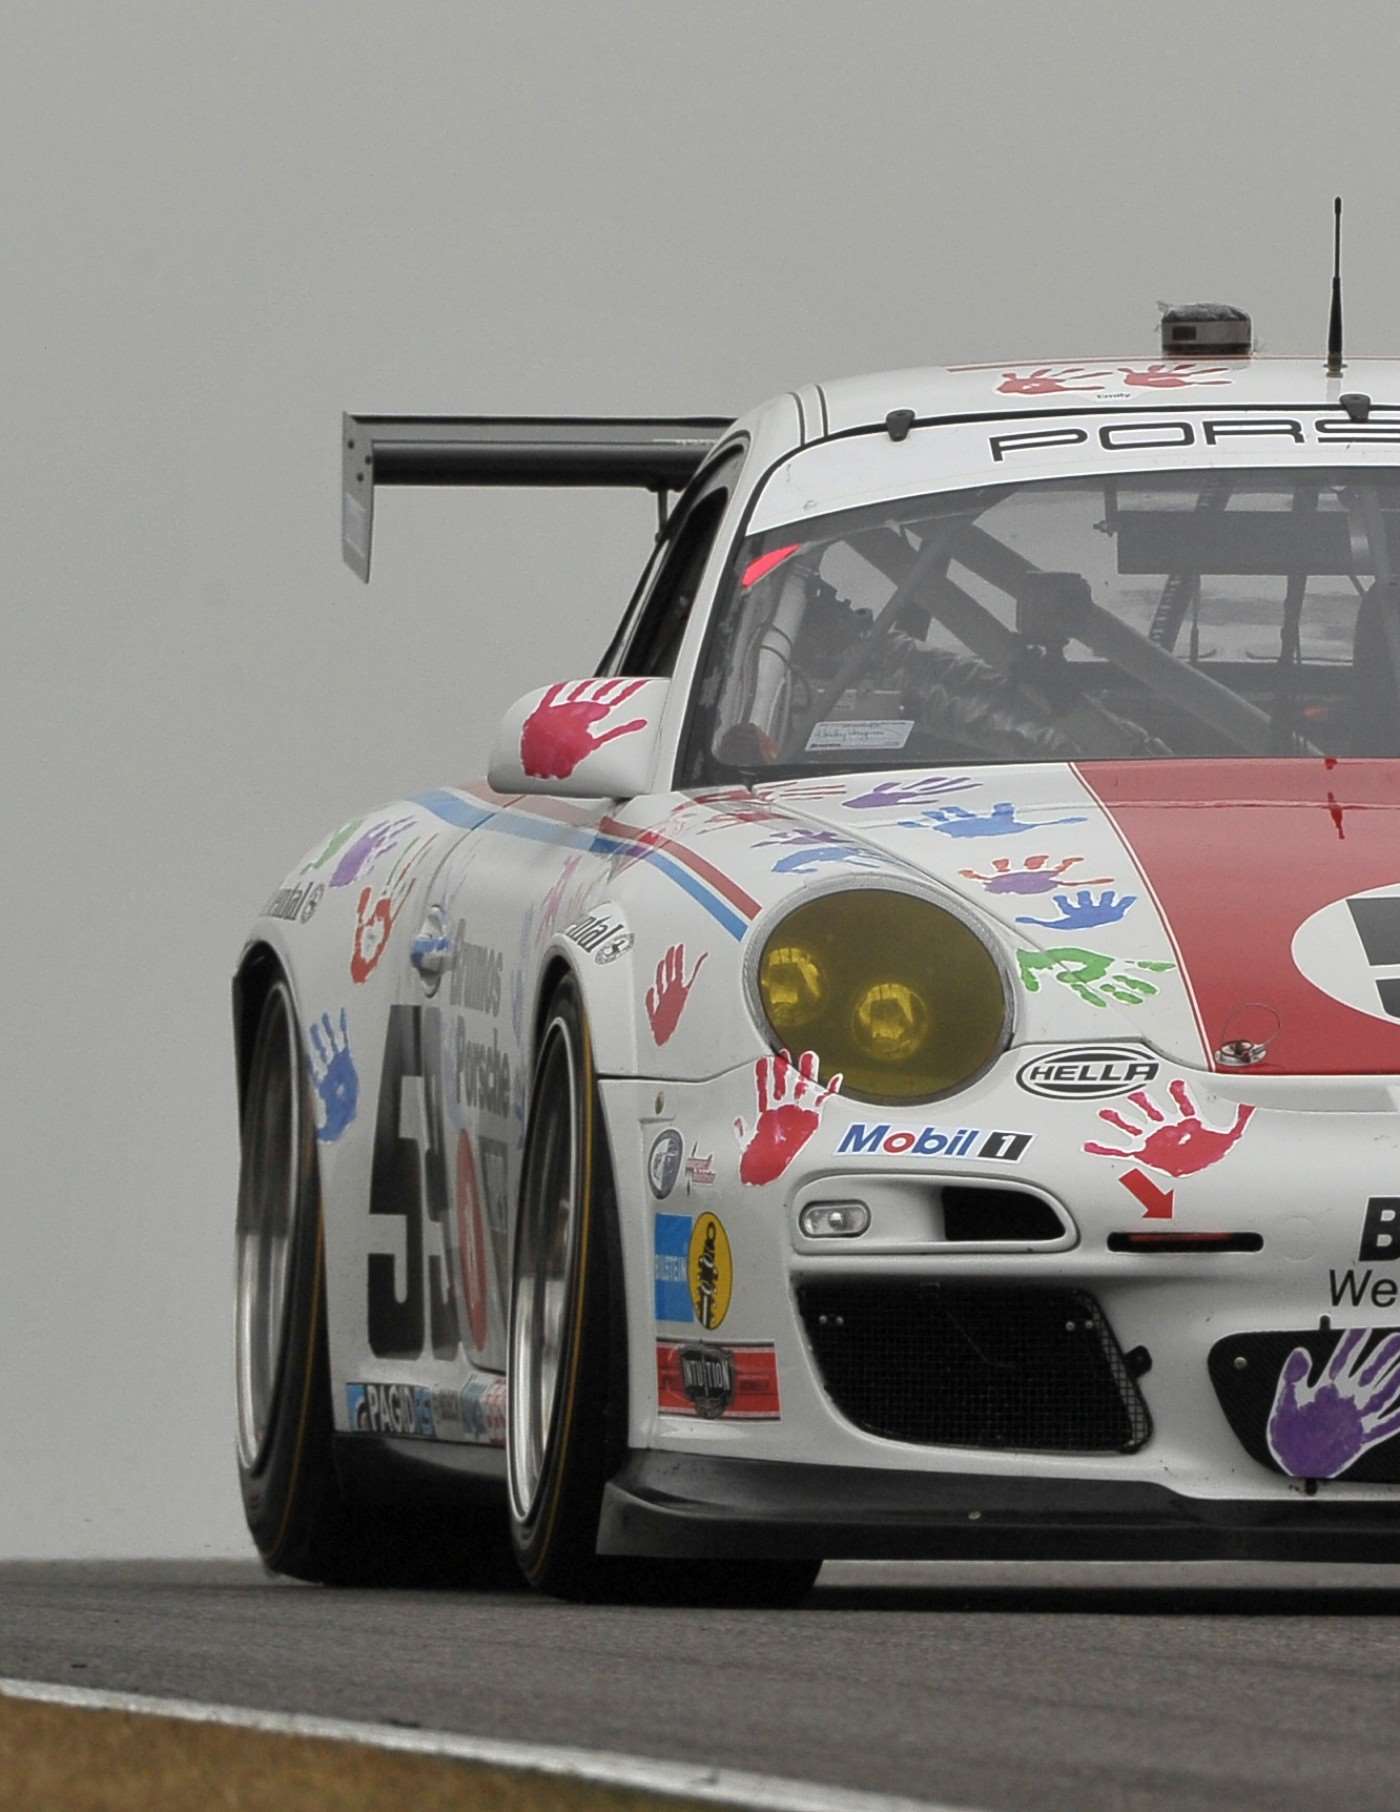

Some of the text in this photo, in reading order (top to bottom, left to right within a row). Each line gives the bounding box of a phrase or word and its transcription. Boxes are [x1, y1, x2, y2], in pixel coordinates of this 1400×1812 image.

[1030, 1060, 1159, 1084] HELLA
[838, 1124, 979, 1156] Mobil
[1329, 1269, 1398, 1307] We
